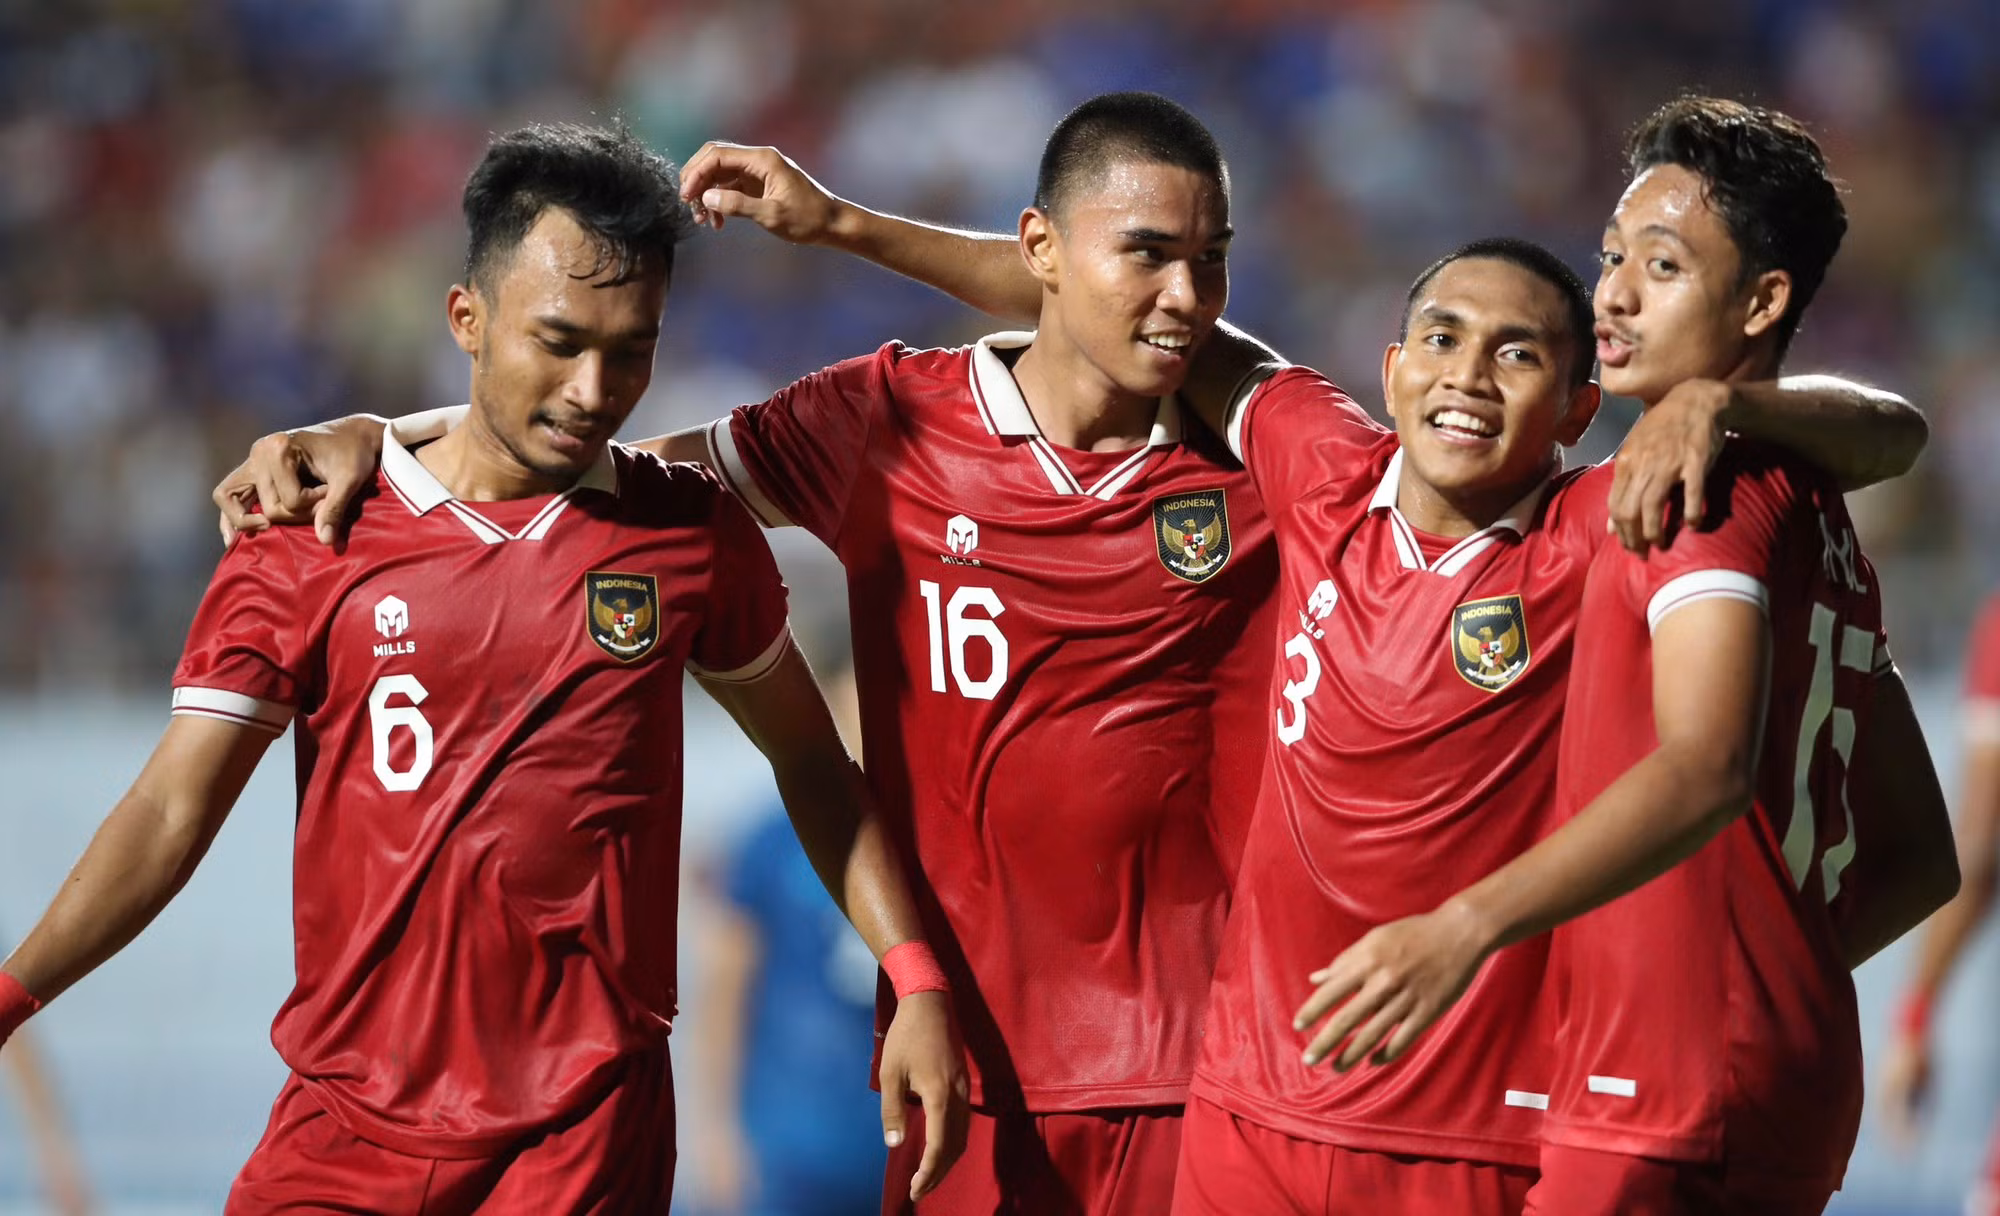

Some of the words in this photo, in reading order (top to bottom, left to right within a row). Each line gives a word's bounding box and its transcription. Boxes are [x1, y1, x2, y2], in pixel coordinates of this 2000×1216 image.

[1163, 498, 1216, 513] INDONESIA
[595, 579, 648, 592] INDONESIA
[1461, 604, 1513, 621] INDONESIA
[373, 640, 416, 657] MILLS
[919, 579, 1009, 701] 16
[1277, 631, 1322, 748] 3
[368, 673, 434, 792] 6
